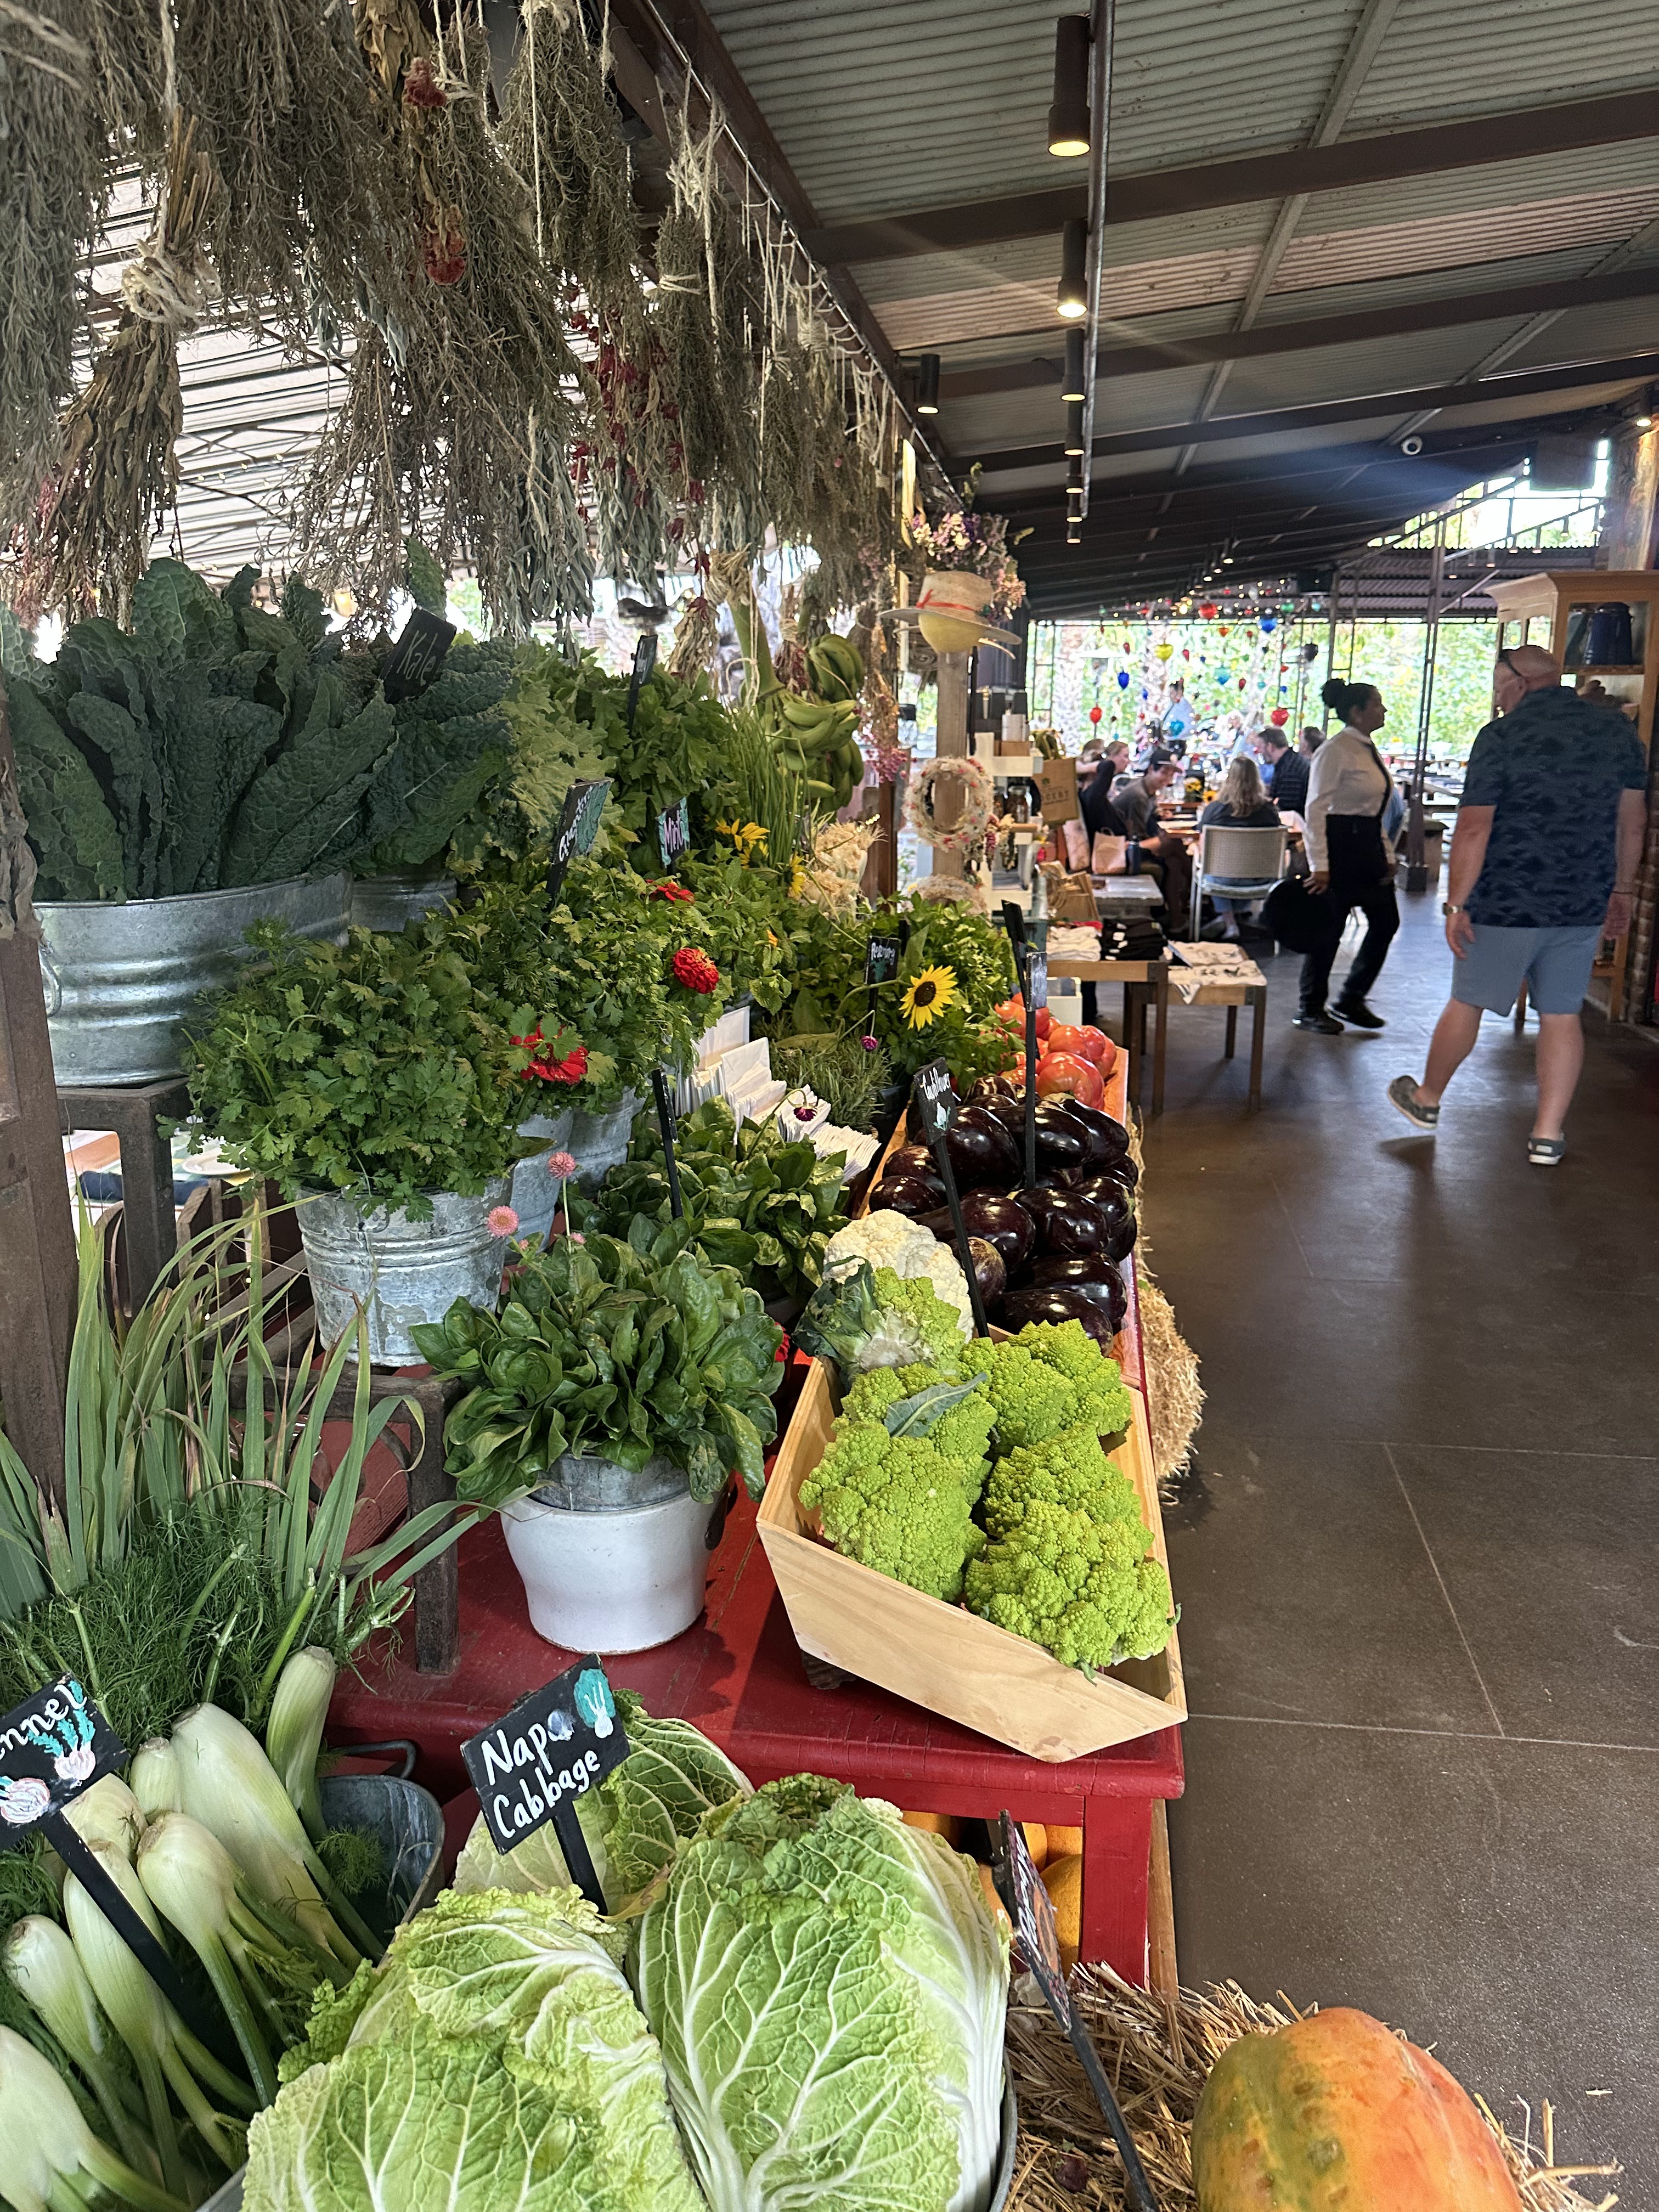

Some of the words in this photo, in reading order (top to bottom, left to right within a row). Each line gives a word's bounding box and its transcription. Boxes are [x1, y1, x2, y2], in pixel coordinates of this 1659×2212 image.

[397, 630, 438, 686] Kale
[664, 810, 684, 856] Mint
[0, 1684, 87, 1760] nnel
[493, 1750, 601, 1838] Cabbage
